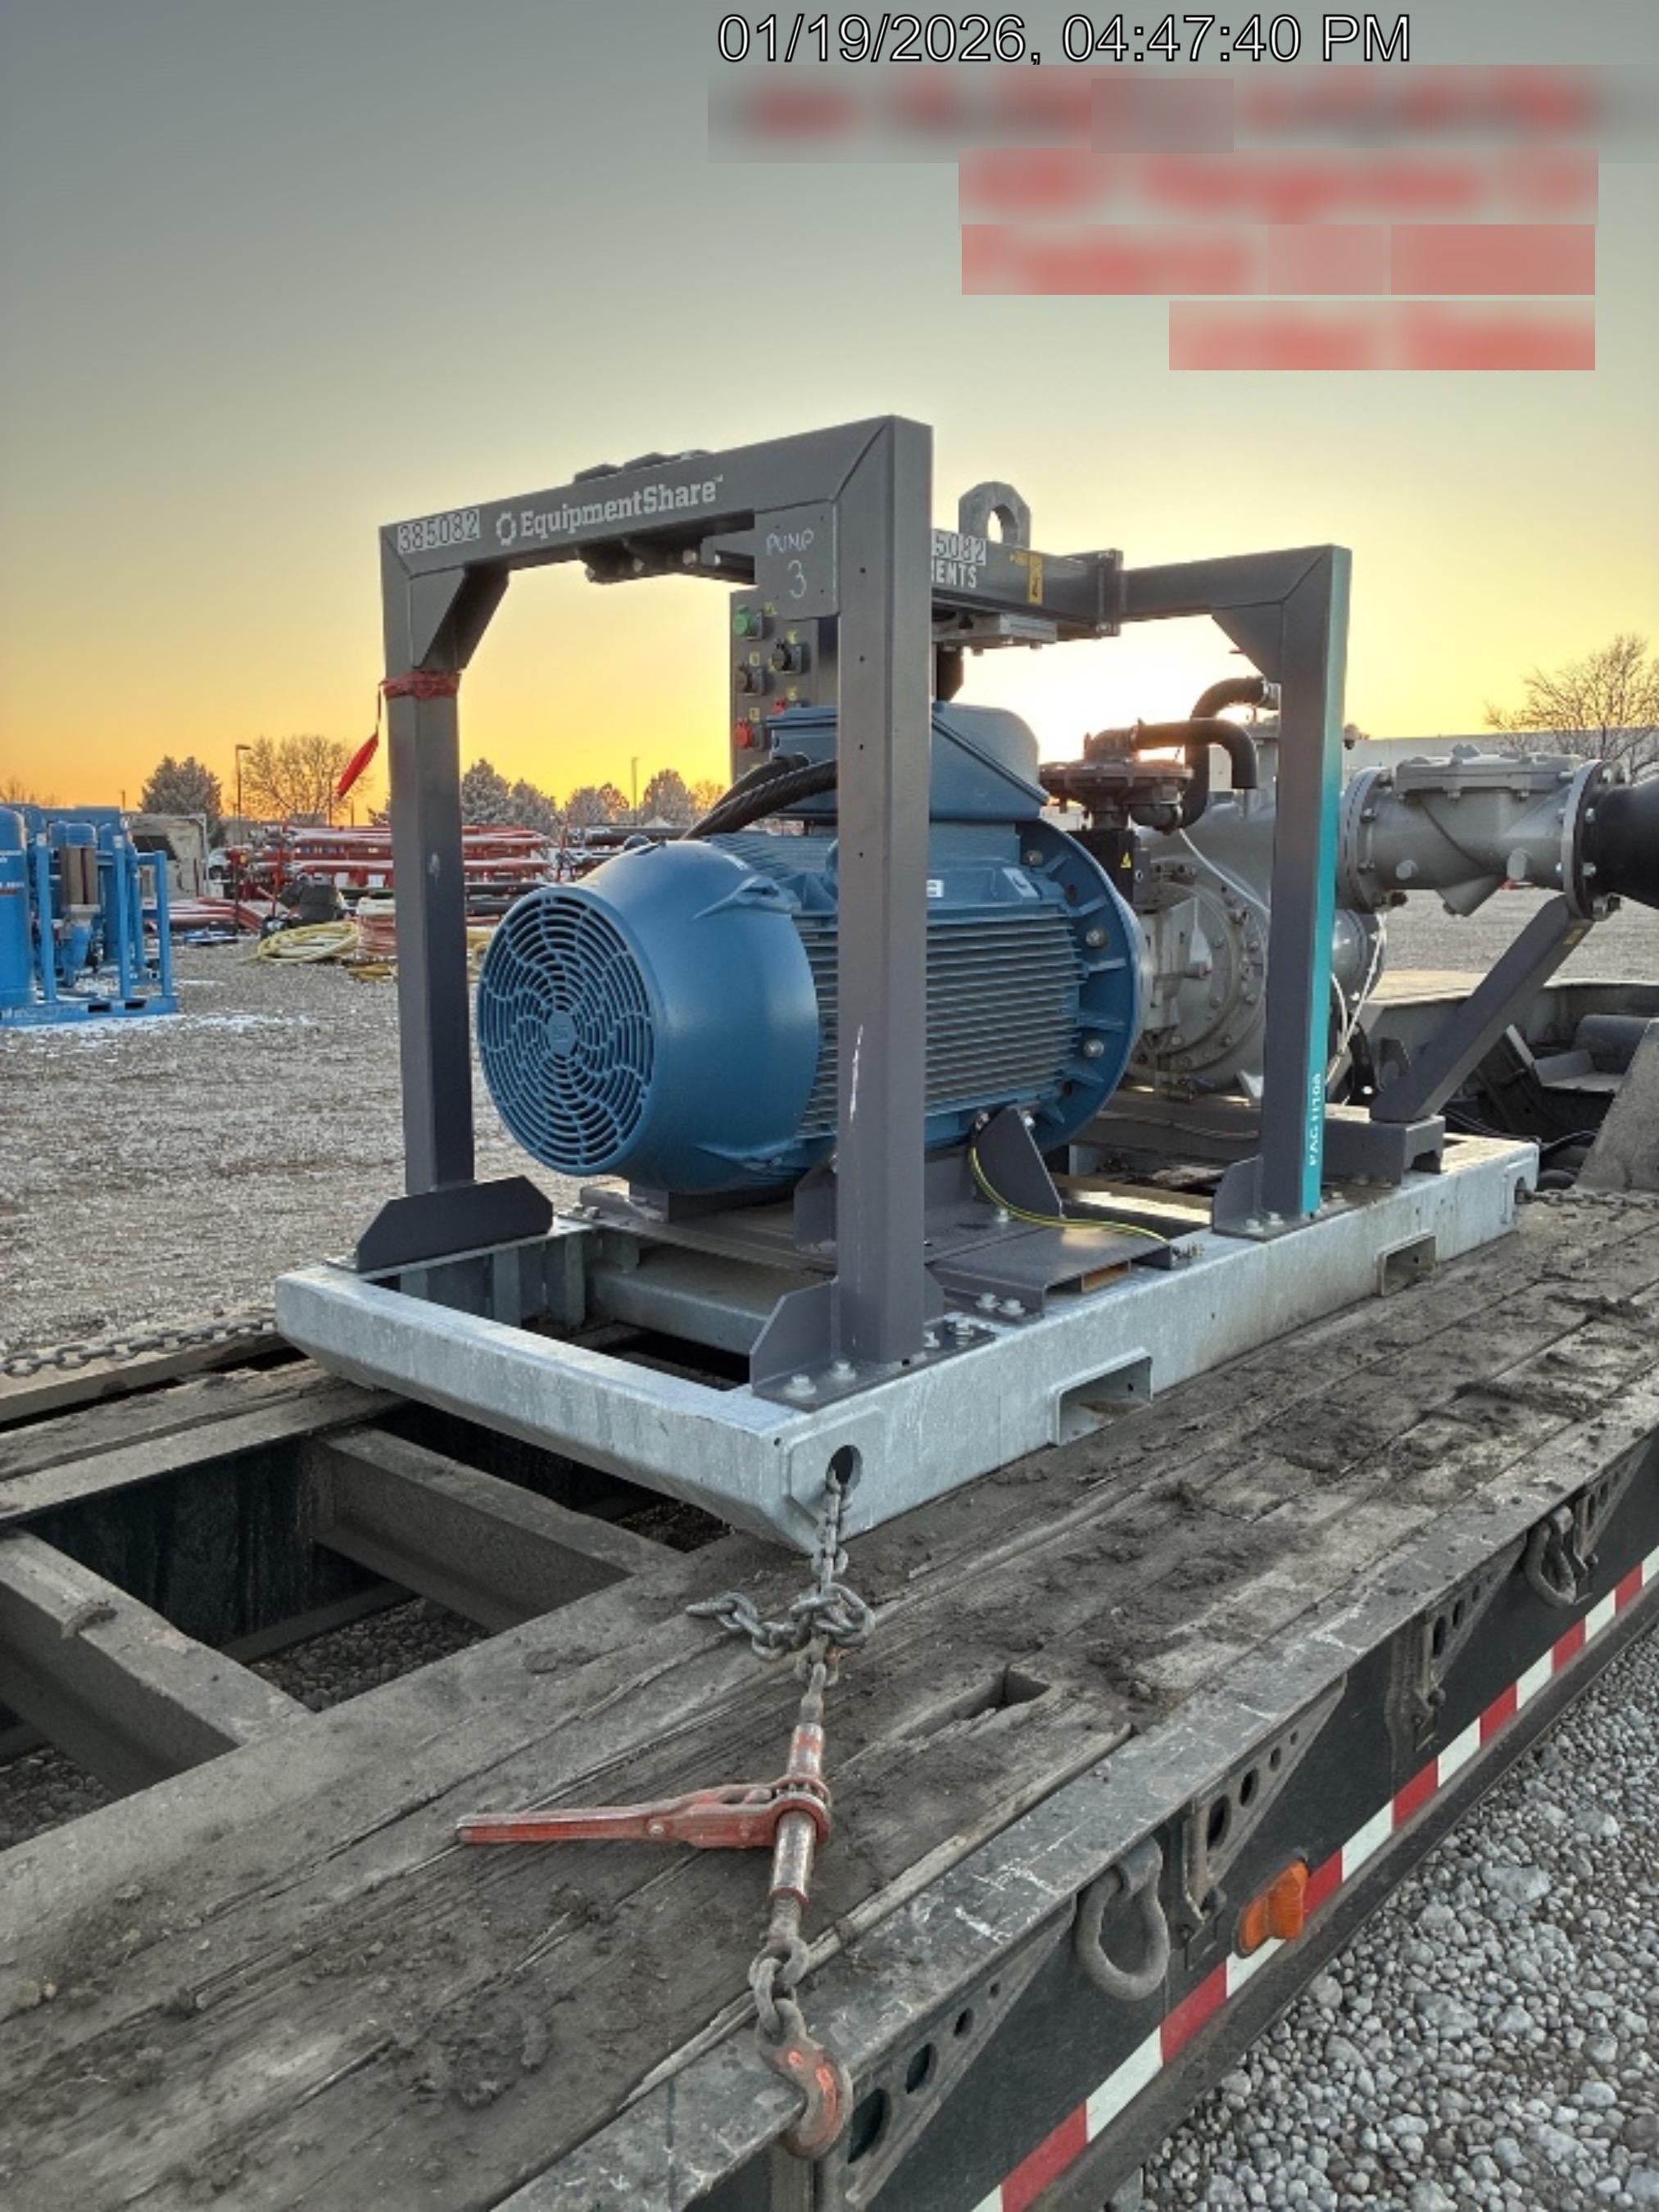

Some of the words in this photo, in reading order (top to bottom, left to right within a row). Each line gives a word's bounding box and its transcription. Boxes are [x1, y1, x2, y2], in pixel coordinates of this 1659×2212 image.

[519, 481, 717, 540] EquipmentShare
[399, 509, 478, 552] 385082
[766, 528, 814, 556] PUMP
[932, 531, 985, 565] 5082
[787, 560, 806, 599] 3
[931, 557, 977, 589] ENTS
